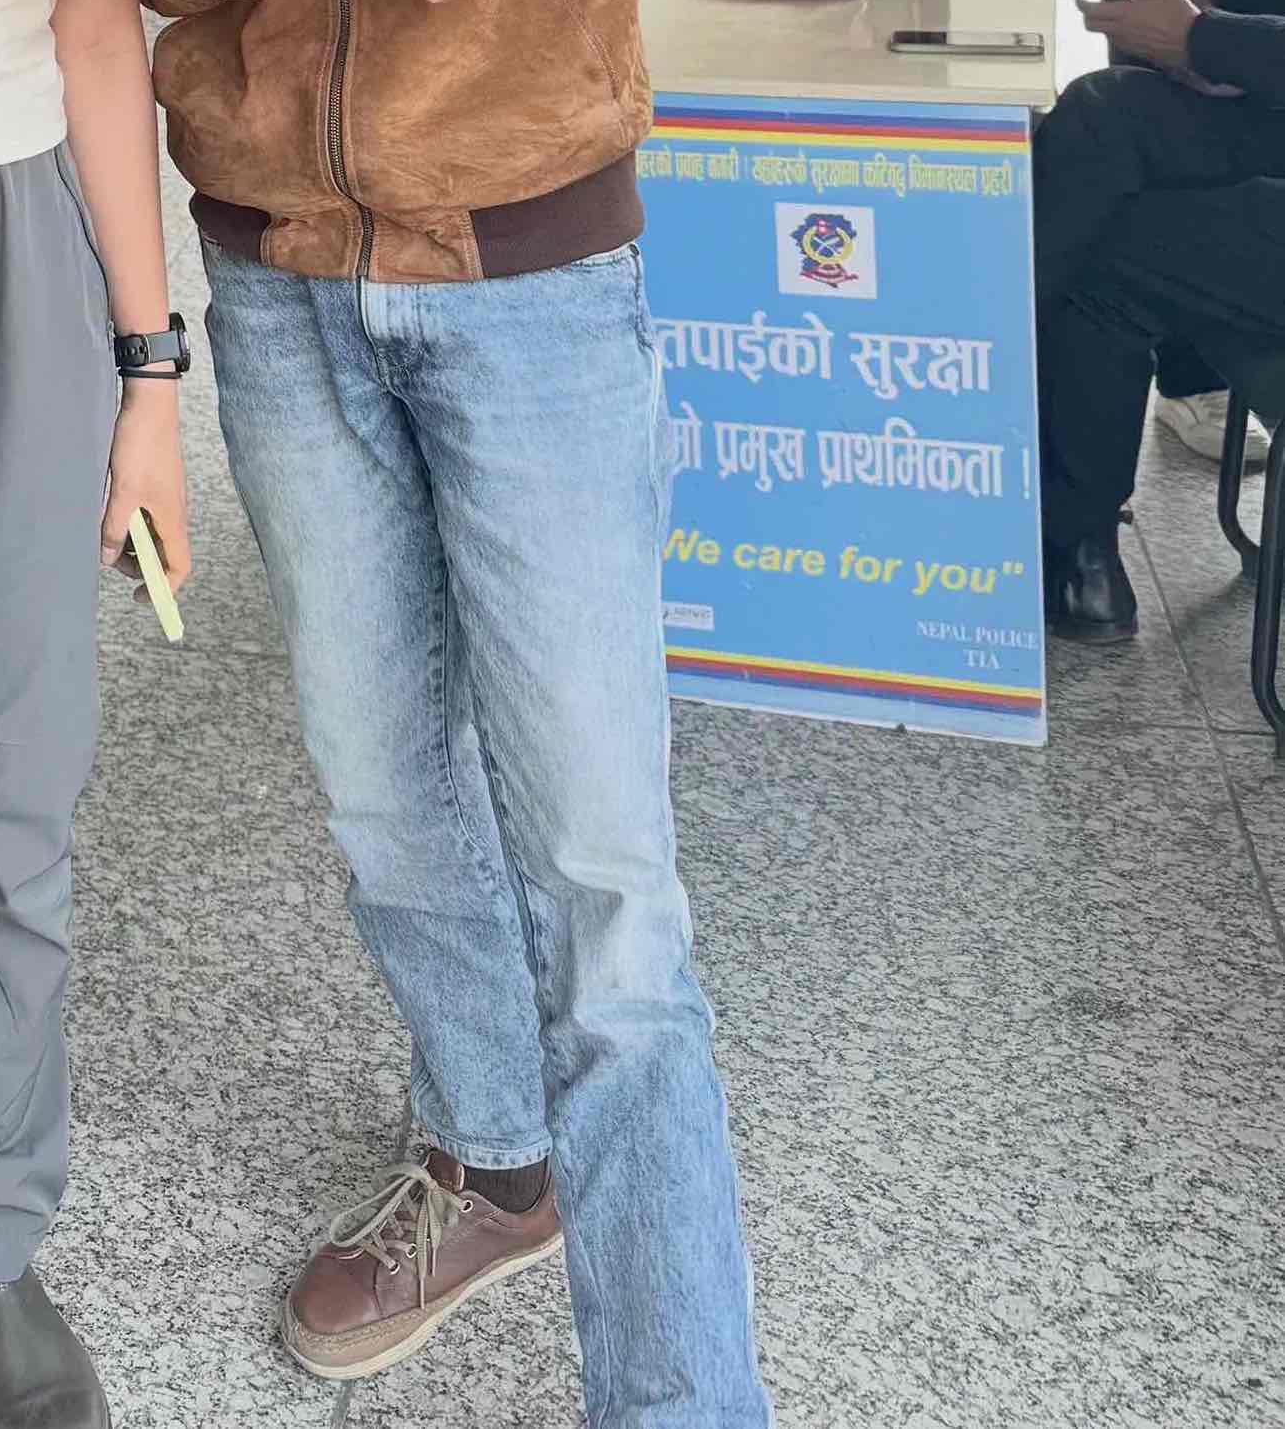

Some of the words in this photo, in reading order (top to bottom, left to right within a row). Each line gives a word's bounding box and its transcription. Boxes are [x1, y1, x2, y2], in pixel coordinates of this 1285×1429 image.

[848, 332, 993, 400] सुरक्षा
[713, 420, 807, 493] प्रमुख
[816, 416, 1004, 498] प्राथमिकता
[732, 542, 827, 576] care
[838, 544, 904, 584] for
[914, 618, 972, 642] NEPAL
[973, 626, 1040, 651] POLICE
[963, 649, 1003, 670] TIA
